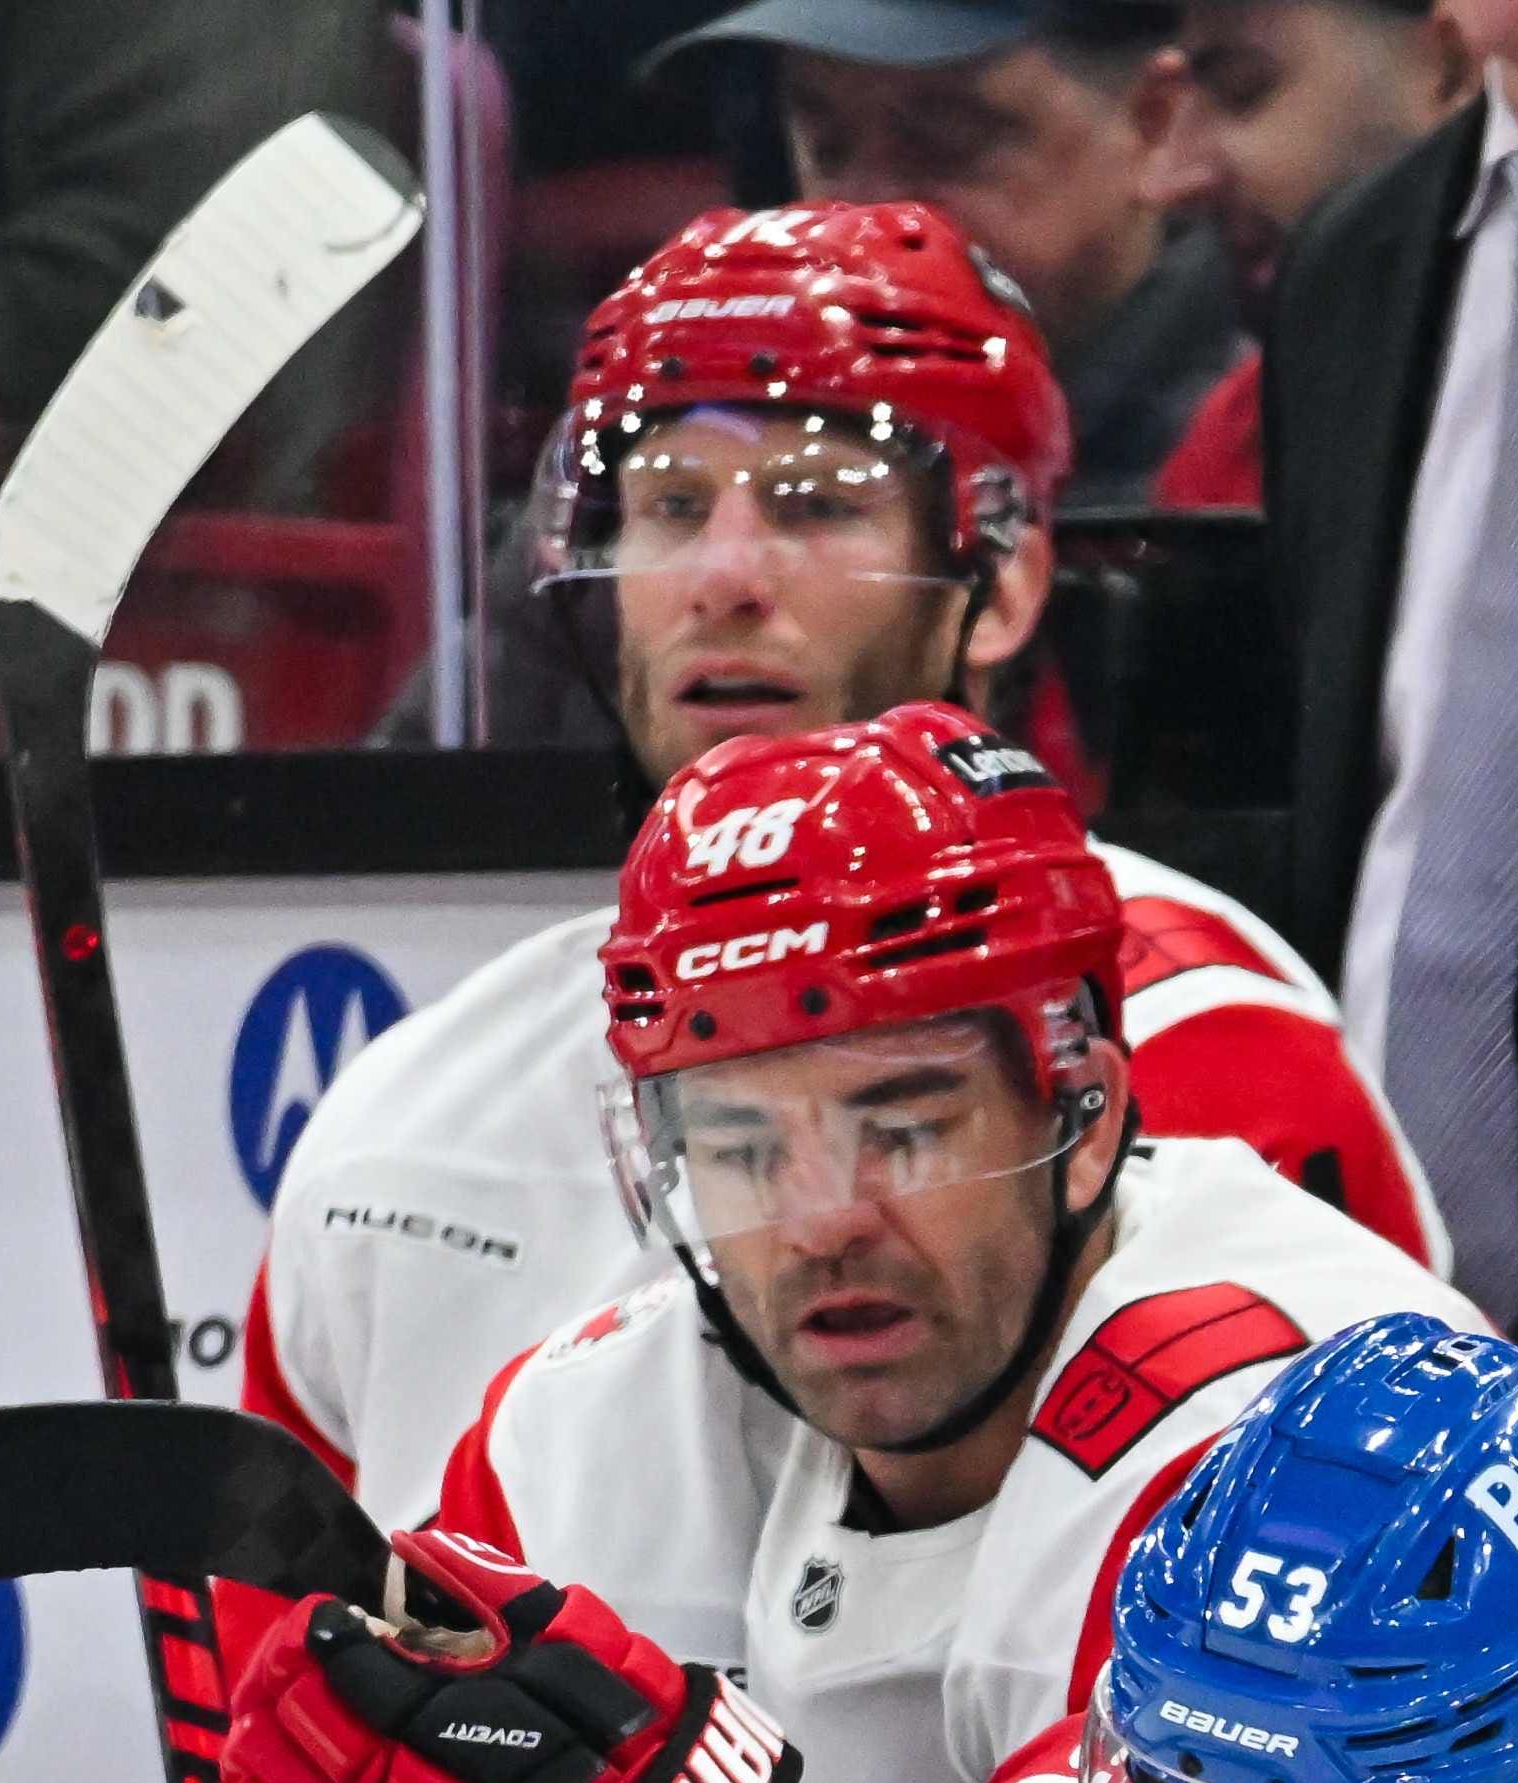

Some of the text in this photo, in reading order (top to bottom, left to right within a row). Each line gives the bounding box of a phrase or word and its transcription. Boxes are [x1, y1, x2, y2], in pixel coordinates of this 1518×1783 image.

[686, 797, 809, 877] 48
[675, 920, 829, 982] CCM
[325, 1208, 519, 1262] NUCOR
[1218, 1550, 1329, 1643] 53
[438, 1722, 543, 1750] COVERT
